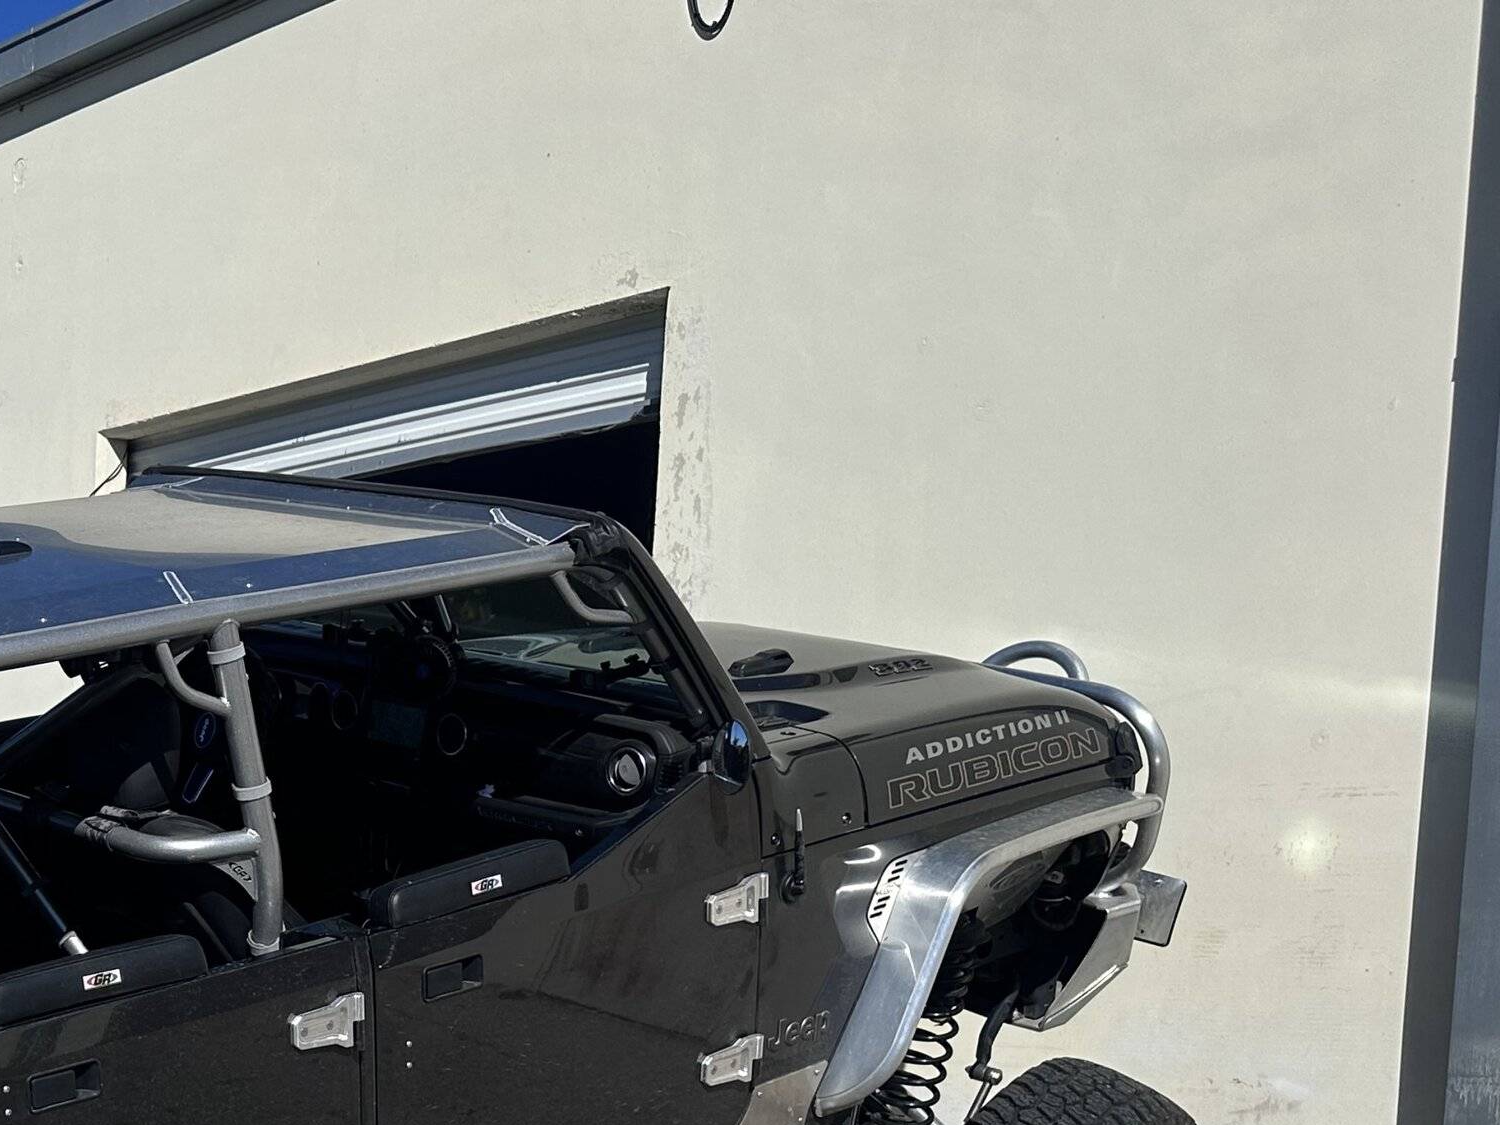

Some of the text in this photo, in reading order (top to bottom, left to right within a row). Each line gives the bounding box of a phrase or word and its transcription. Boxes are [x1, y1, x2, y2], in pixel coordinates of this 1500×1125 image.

[905, 709, 1070, 765] ADDICTION II
[887, 727, 1100, 809] RUBICON
[767, 1010, 831, 1052] Jeep
